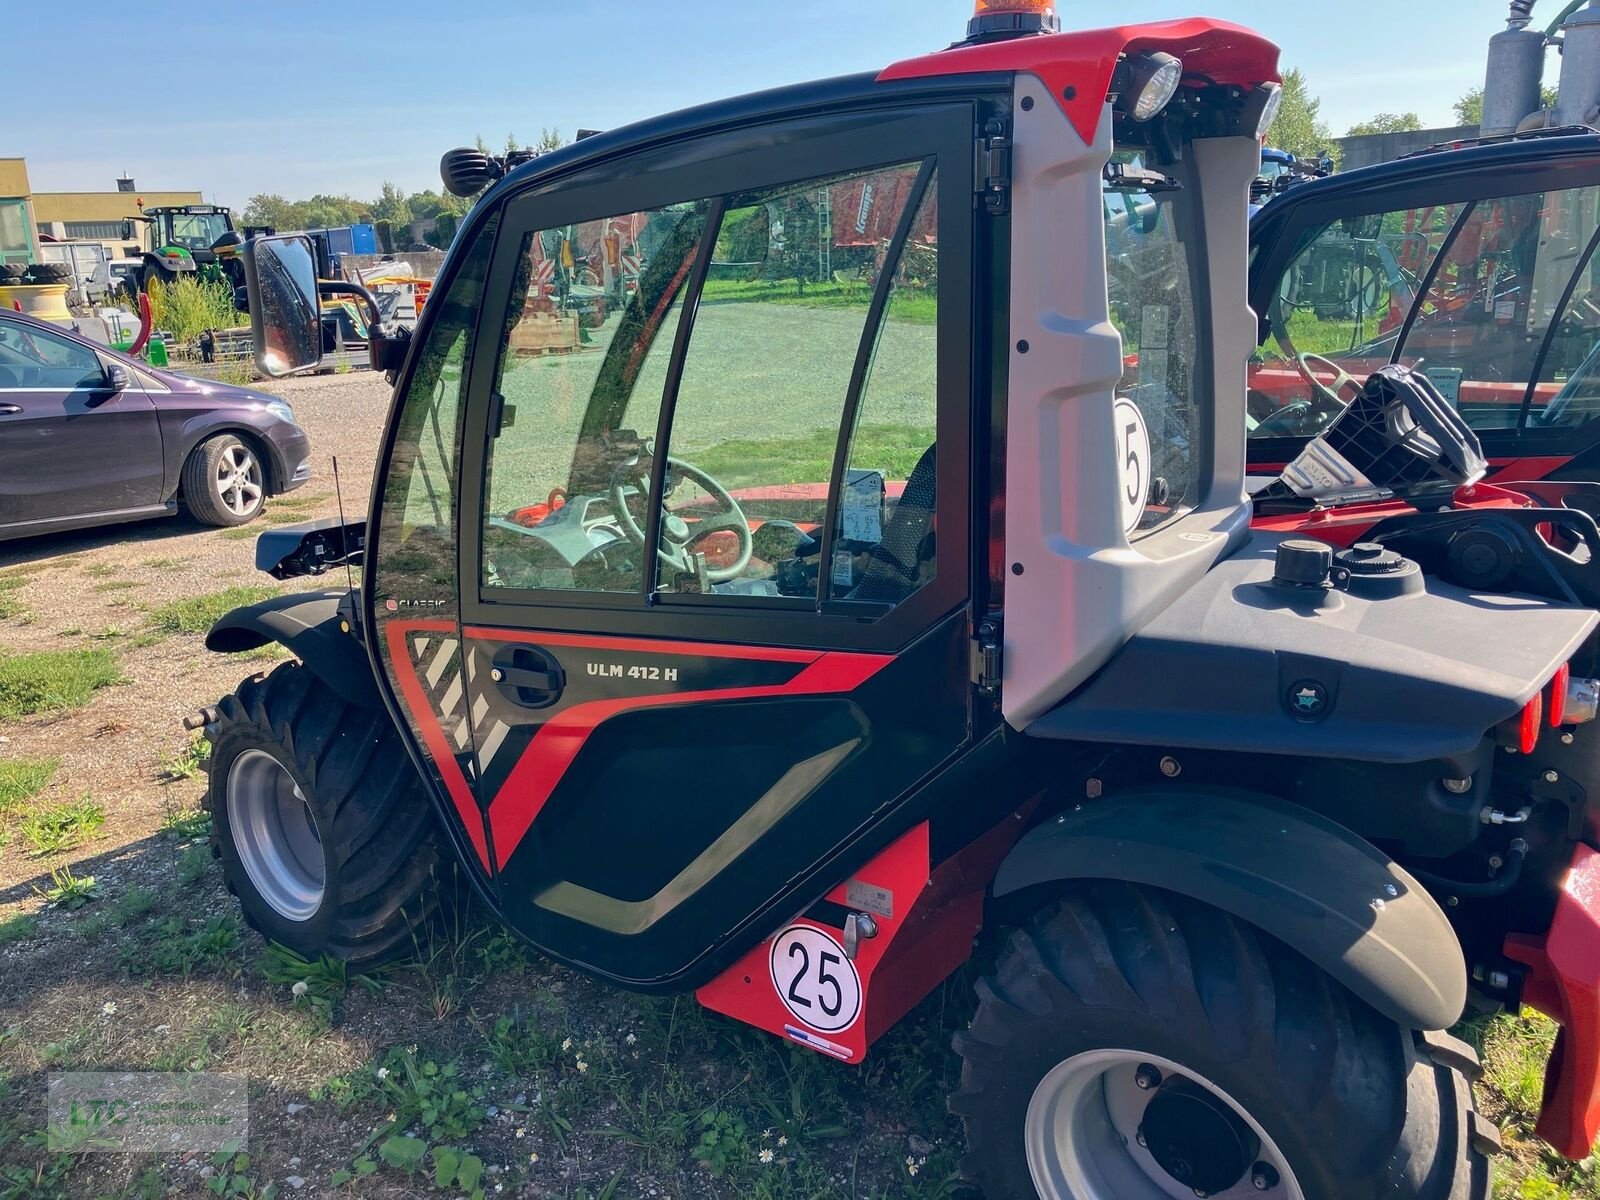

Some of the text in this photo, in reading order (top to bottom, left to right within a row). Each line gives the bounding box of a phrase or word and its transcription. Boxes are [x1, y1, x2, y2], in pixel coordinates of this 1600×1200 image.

[1117, 421, 1140, 506] 5
[587, 663, 678, 682] ULM 412 H
[788, 941, 842, 1016] 25
